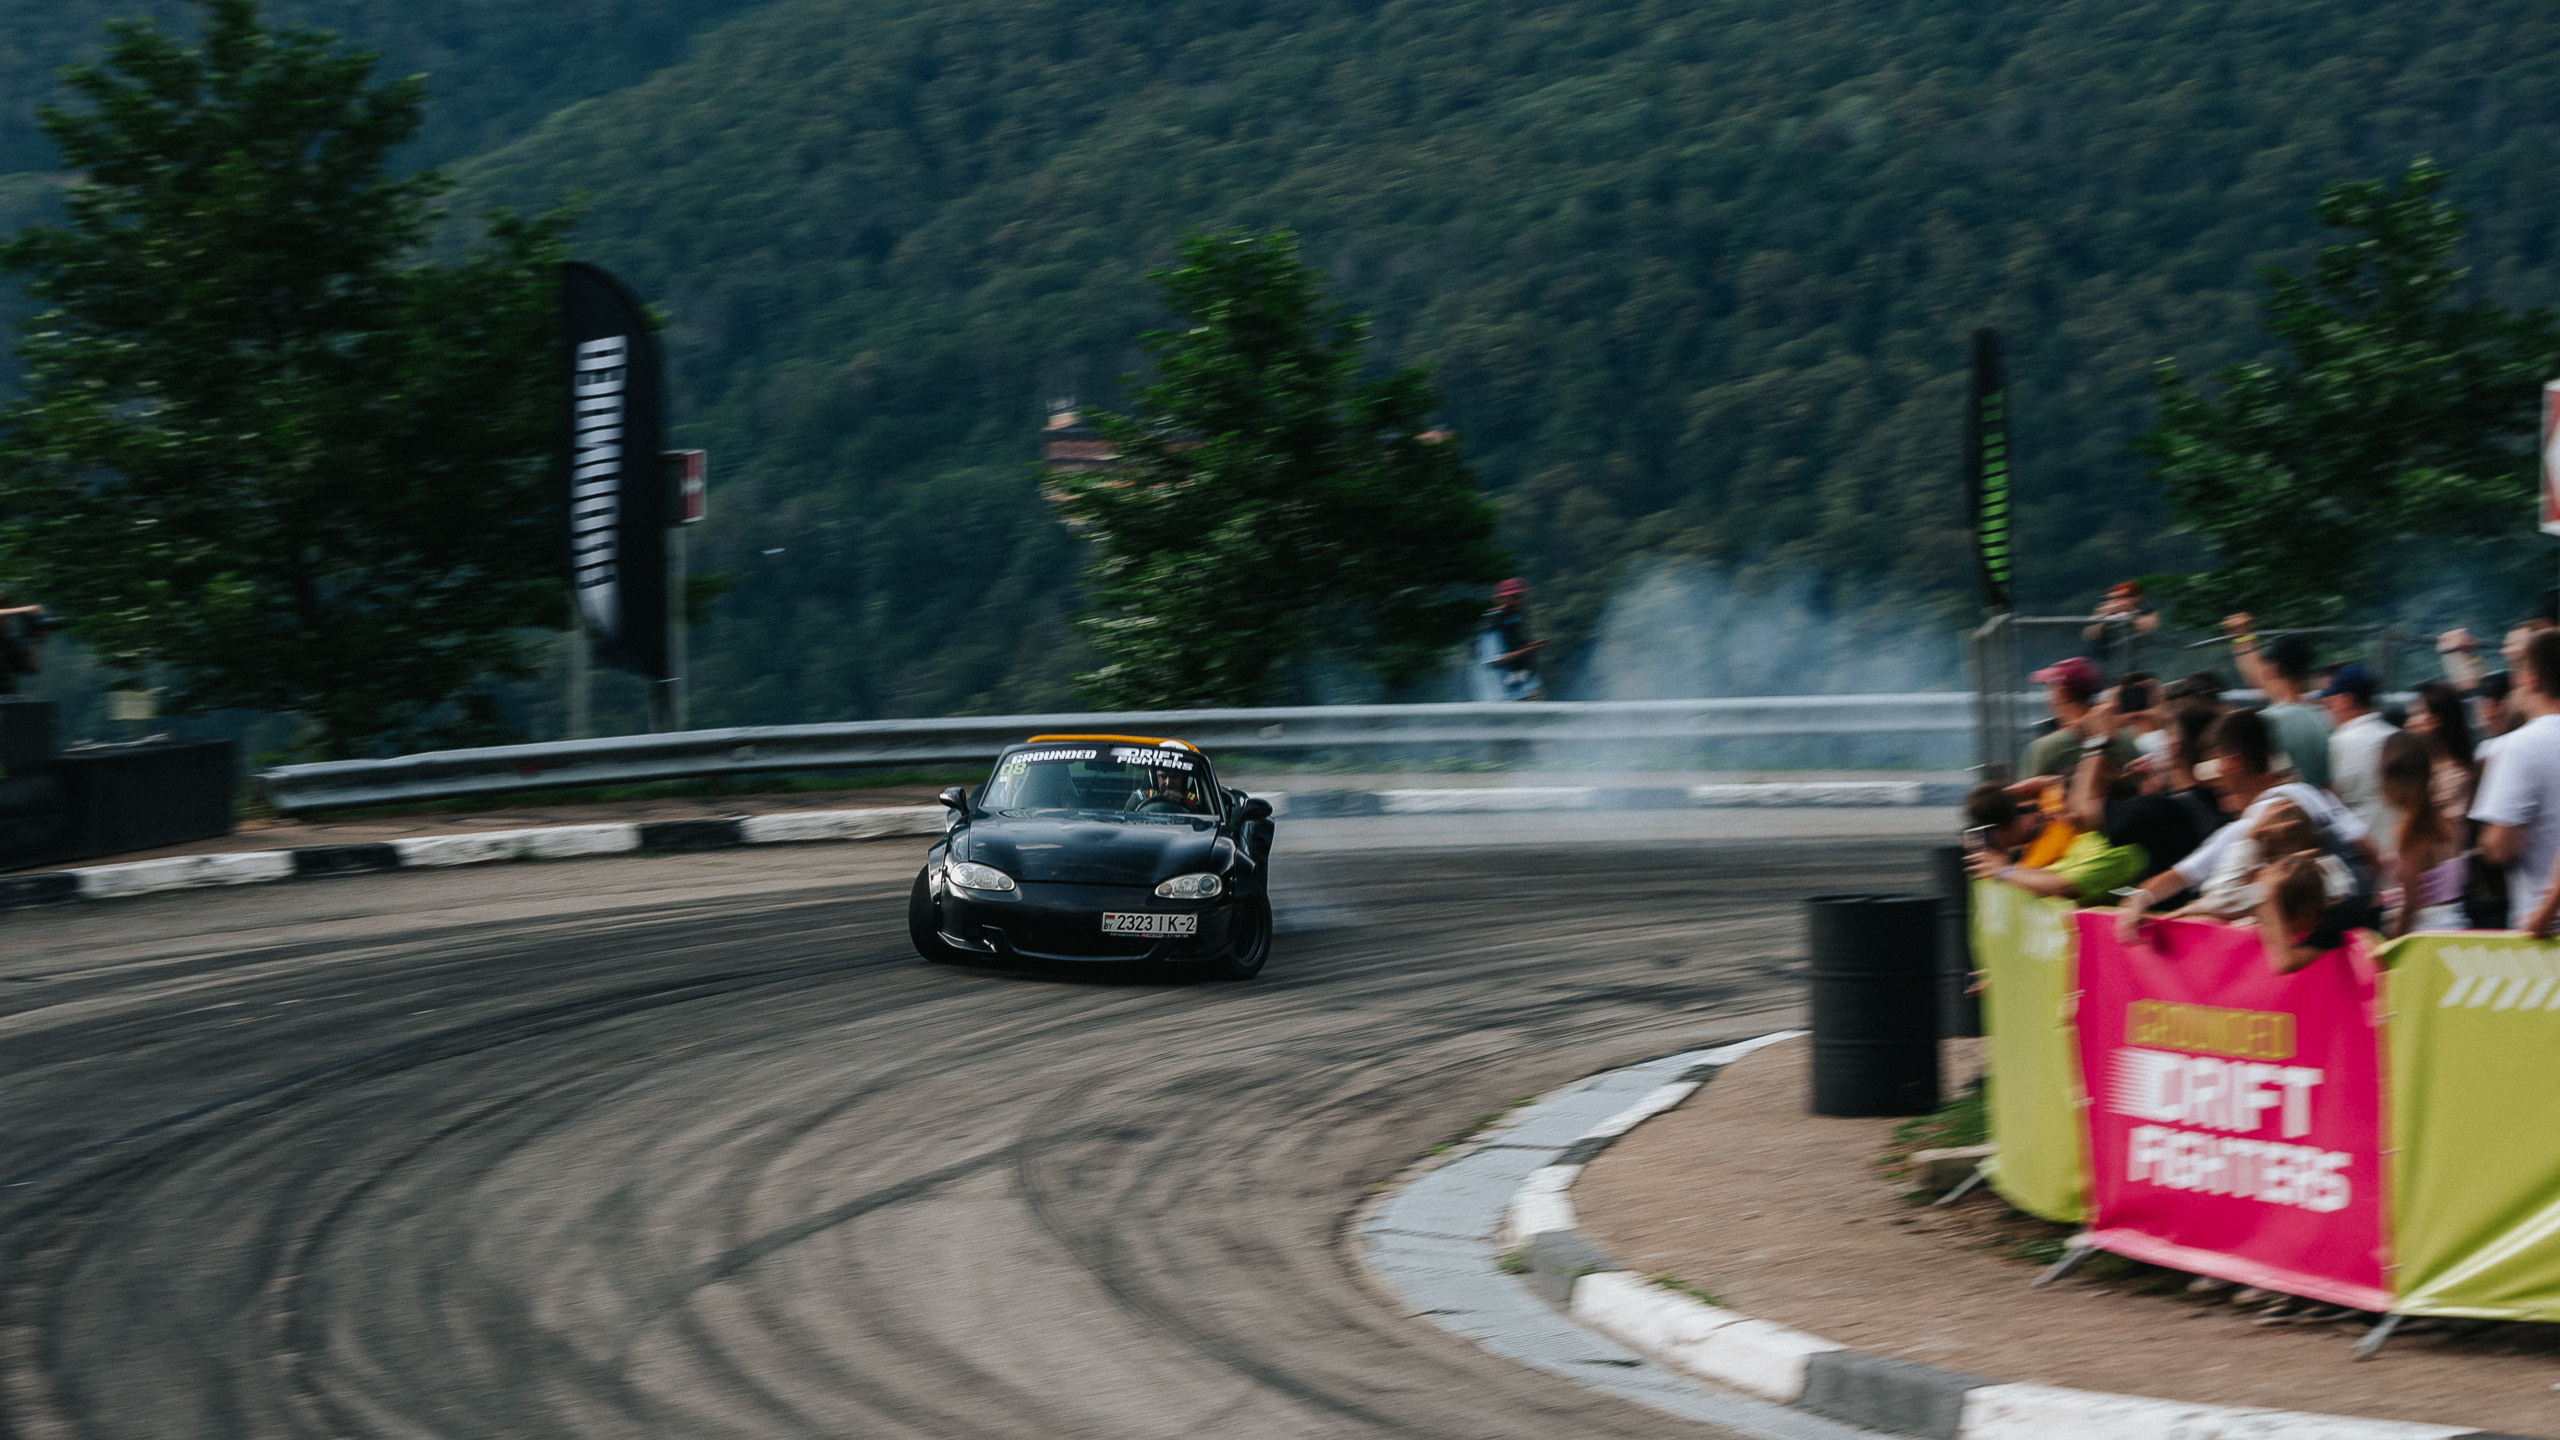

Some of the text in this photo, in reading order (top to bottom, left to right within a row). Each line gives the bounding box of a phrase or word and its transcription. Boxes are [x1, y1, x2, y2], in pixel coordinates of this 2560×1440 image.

[1011, 749, 1097, 764] GROUNDED
[1110, 747, 1184, 763] DRIFT
[1116, 755, 1194, 771] FIGHTERS
[1103, 922, 1113, 930] BY
[1117, 915, 1153, 931] 2323
[2102, 1046, 2324, 1138] DRIFT
[2127, 1124, 2353, 1213] FIGHTERS
